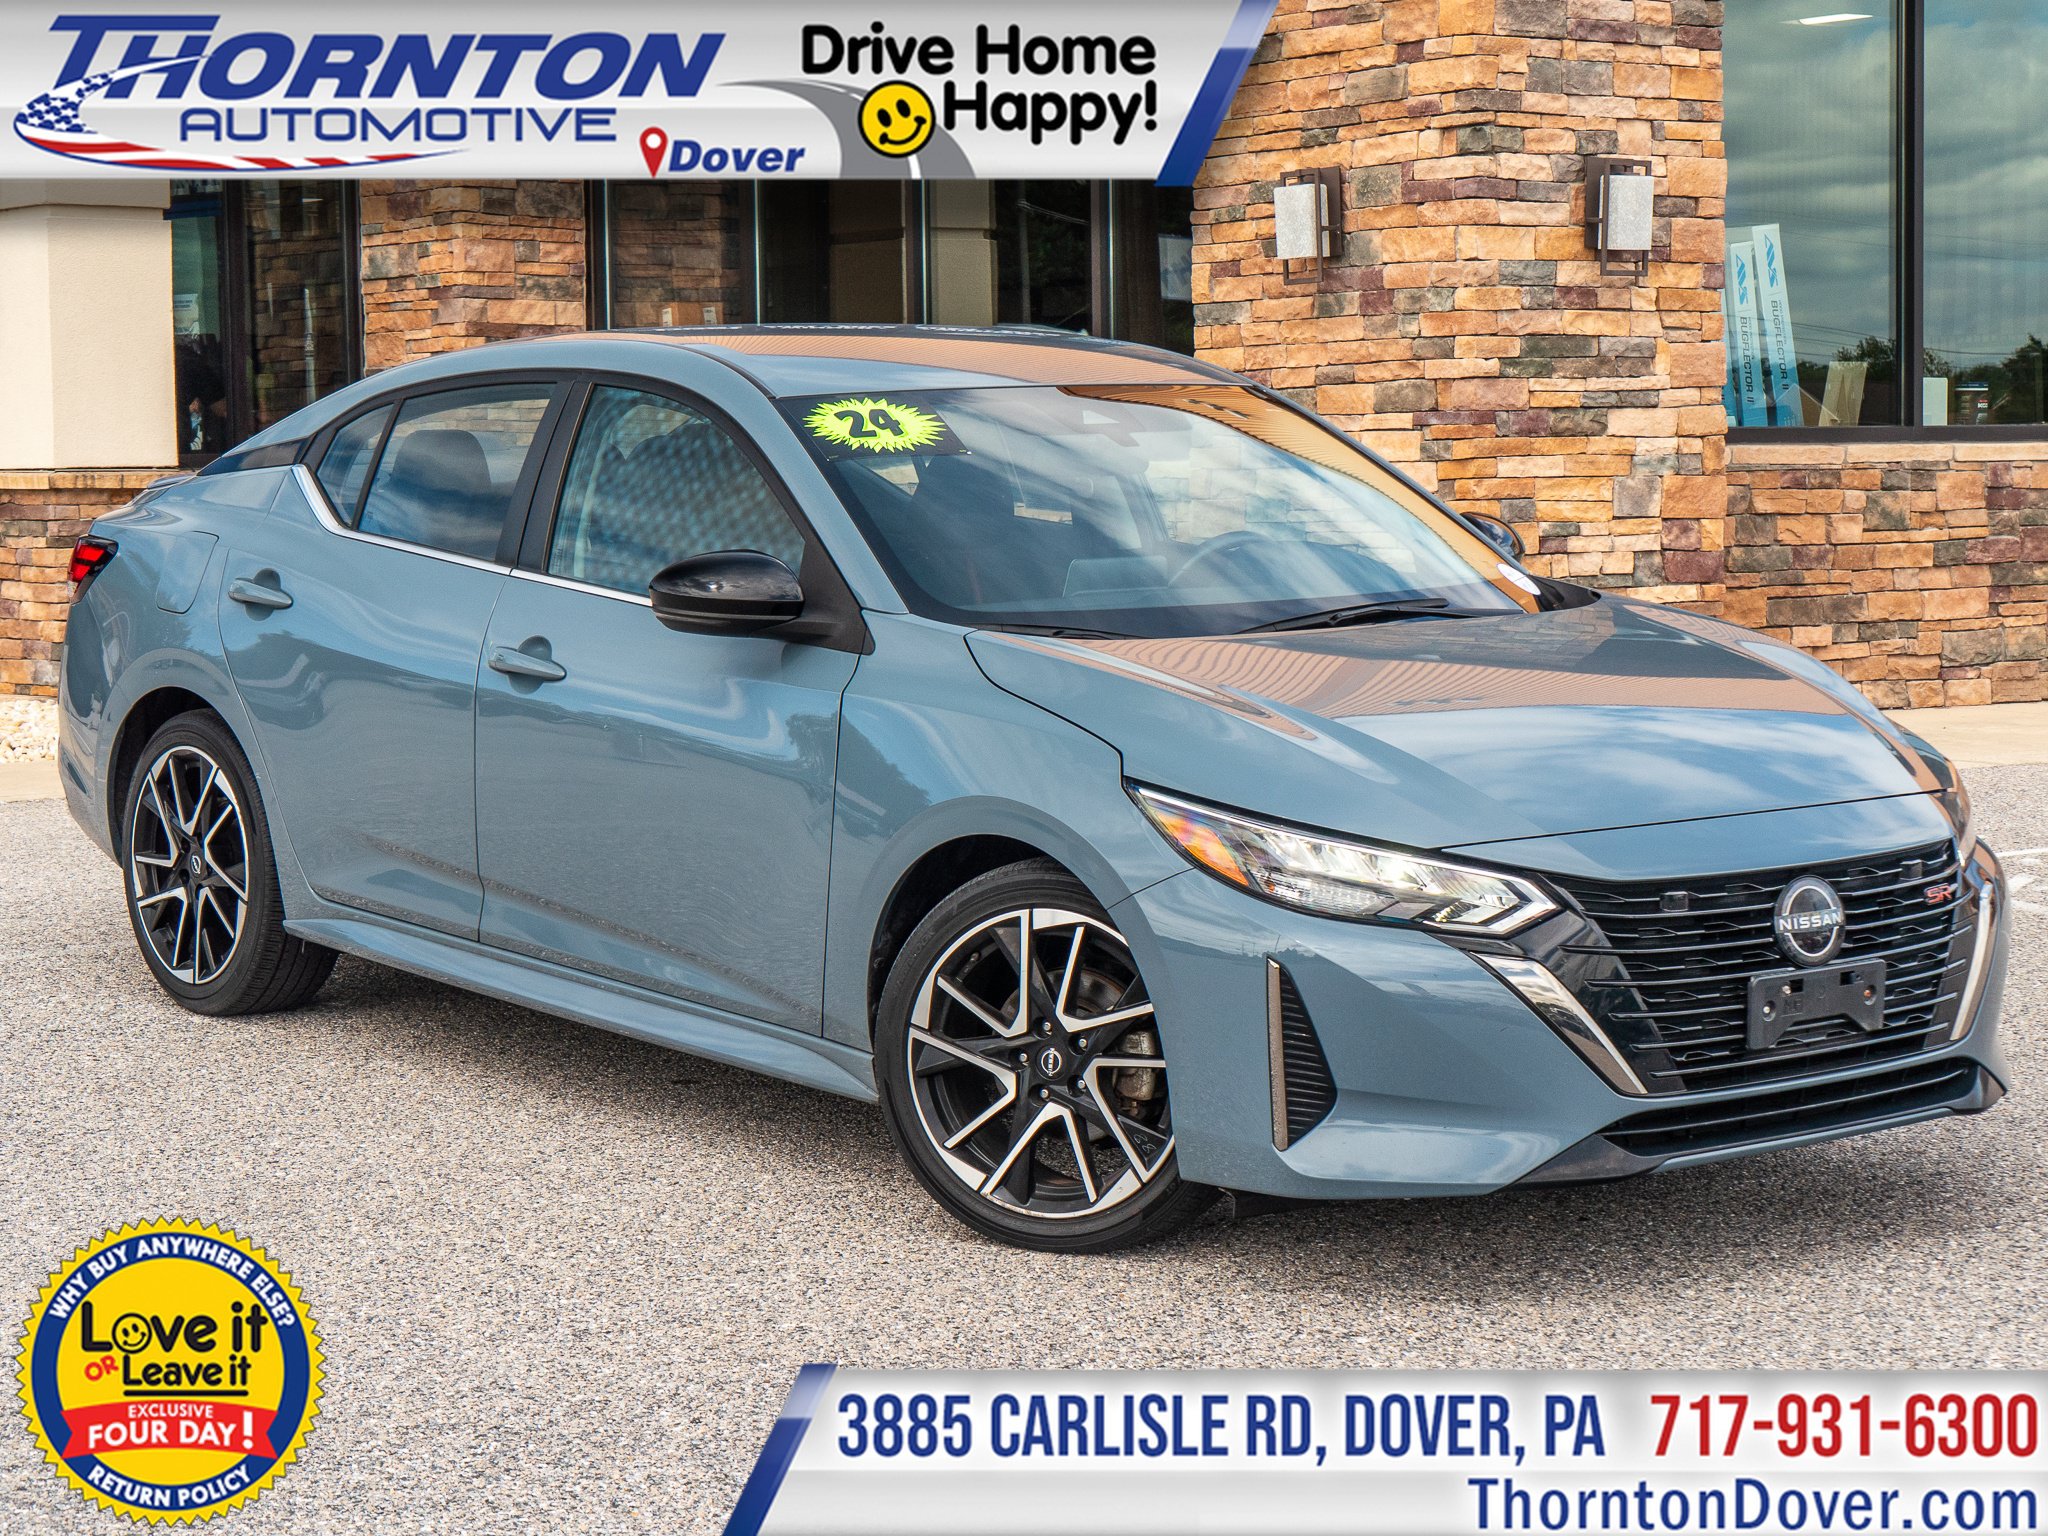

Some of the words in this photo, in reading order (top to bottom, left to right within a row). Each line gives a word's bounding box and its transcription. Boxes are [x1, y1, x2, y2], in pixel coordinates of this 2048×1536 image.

[1740, 316, 1754, 393] BUGFLECTOR
[1770, 300, 1788, 380] BUGFLECTOR
[834, 409, 904, 438] 24
[1925, 883, 1953, 905] SR
[1779, 911, 1842, 931] NISSAN
